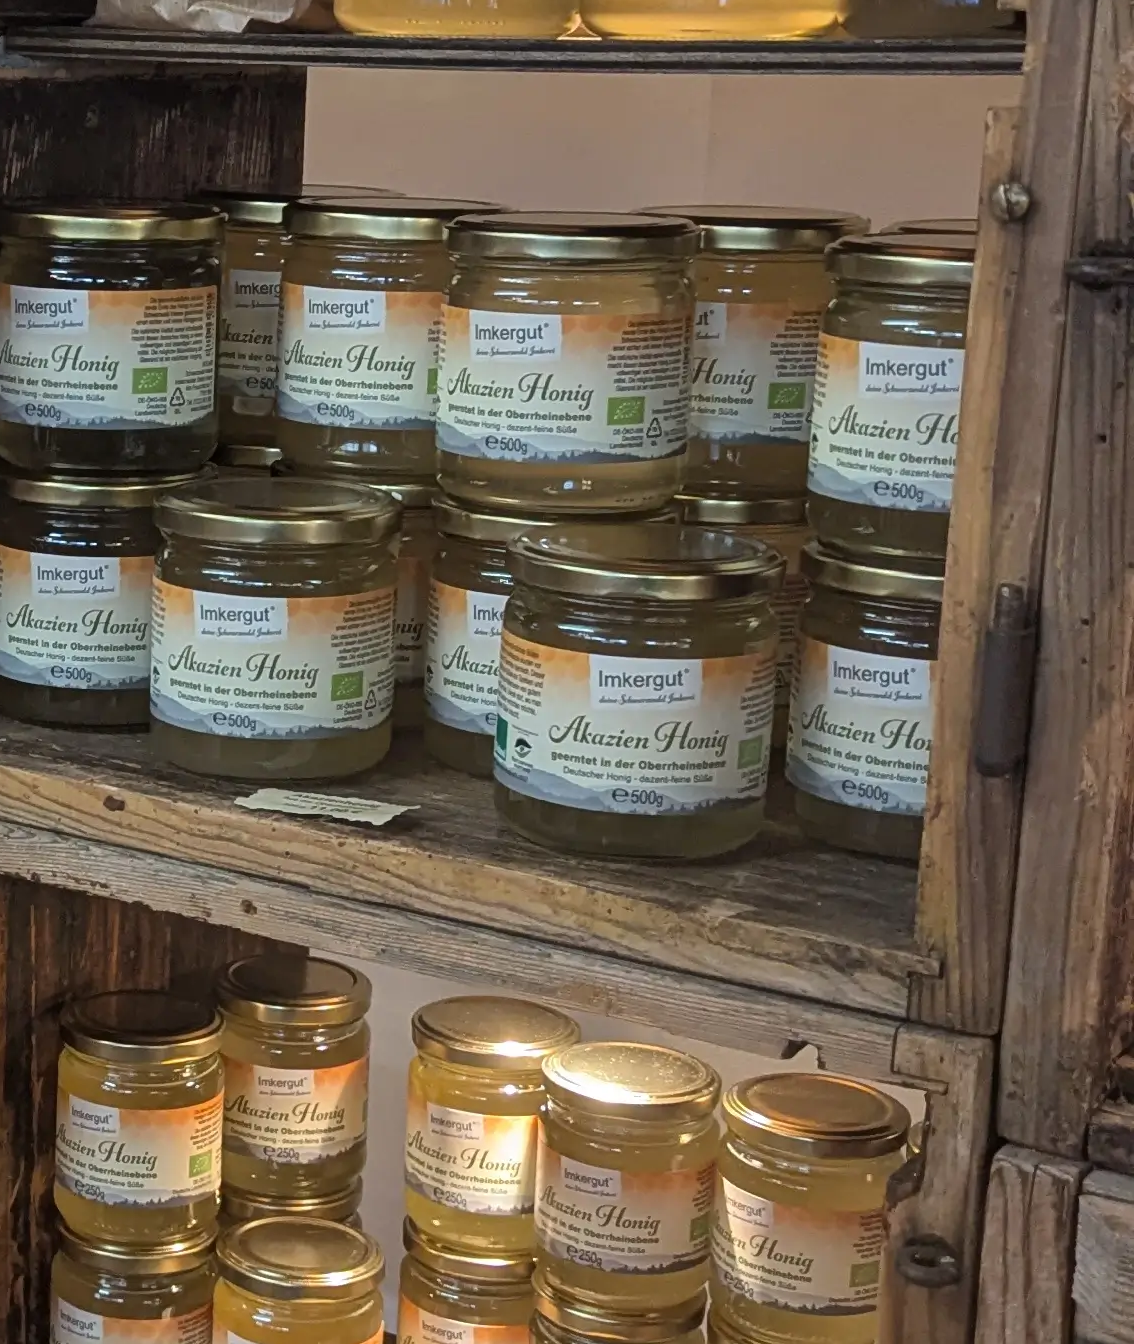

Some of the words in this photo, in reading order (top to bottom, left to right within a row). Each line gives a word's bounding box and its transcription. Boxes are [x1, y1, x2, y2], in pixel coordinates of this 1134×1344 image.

[51, 344, 120, 381] Honig
[284, 339, 343, 369] Akazien
[347, 344, 415, 380] Honig
[335, 379, 414, 391] Oberrheinebene
[447, 367, 514, 399] Akazien
[518, 371, 594, 410] Honig
[506, 409, 592, 422] Oberrheinebene
[828, 404, 910, 442] Akazien
[866, 448, 875, 458] in
[878, 449, 896, 461] der
[6, 604, 78, 634] Akazien
[81, 609, 148, 641] Honig
[52, 641, 67, 650] der
[168, 645, 241, 678] Akazien
[246, 651, 319, 689] Honig
[234, 687, 317, 699] Oberrheinebene
[549, 715, 649, 751] Akazien
[654, 720, 729, 757] Honig
[801, 703, 876, 744] Akazien
[600, 756, 611, 768] in
[615, 758, 636, 770] der
[225, 1095, 289, 1122] Akazien
[98, 1140, 158, 1171] Honig
[596, 1205, 661, 1237] Honig
[749, 1234, 814, 1275] Honig
